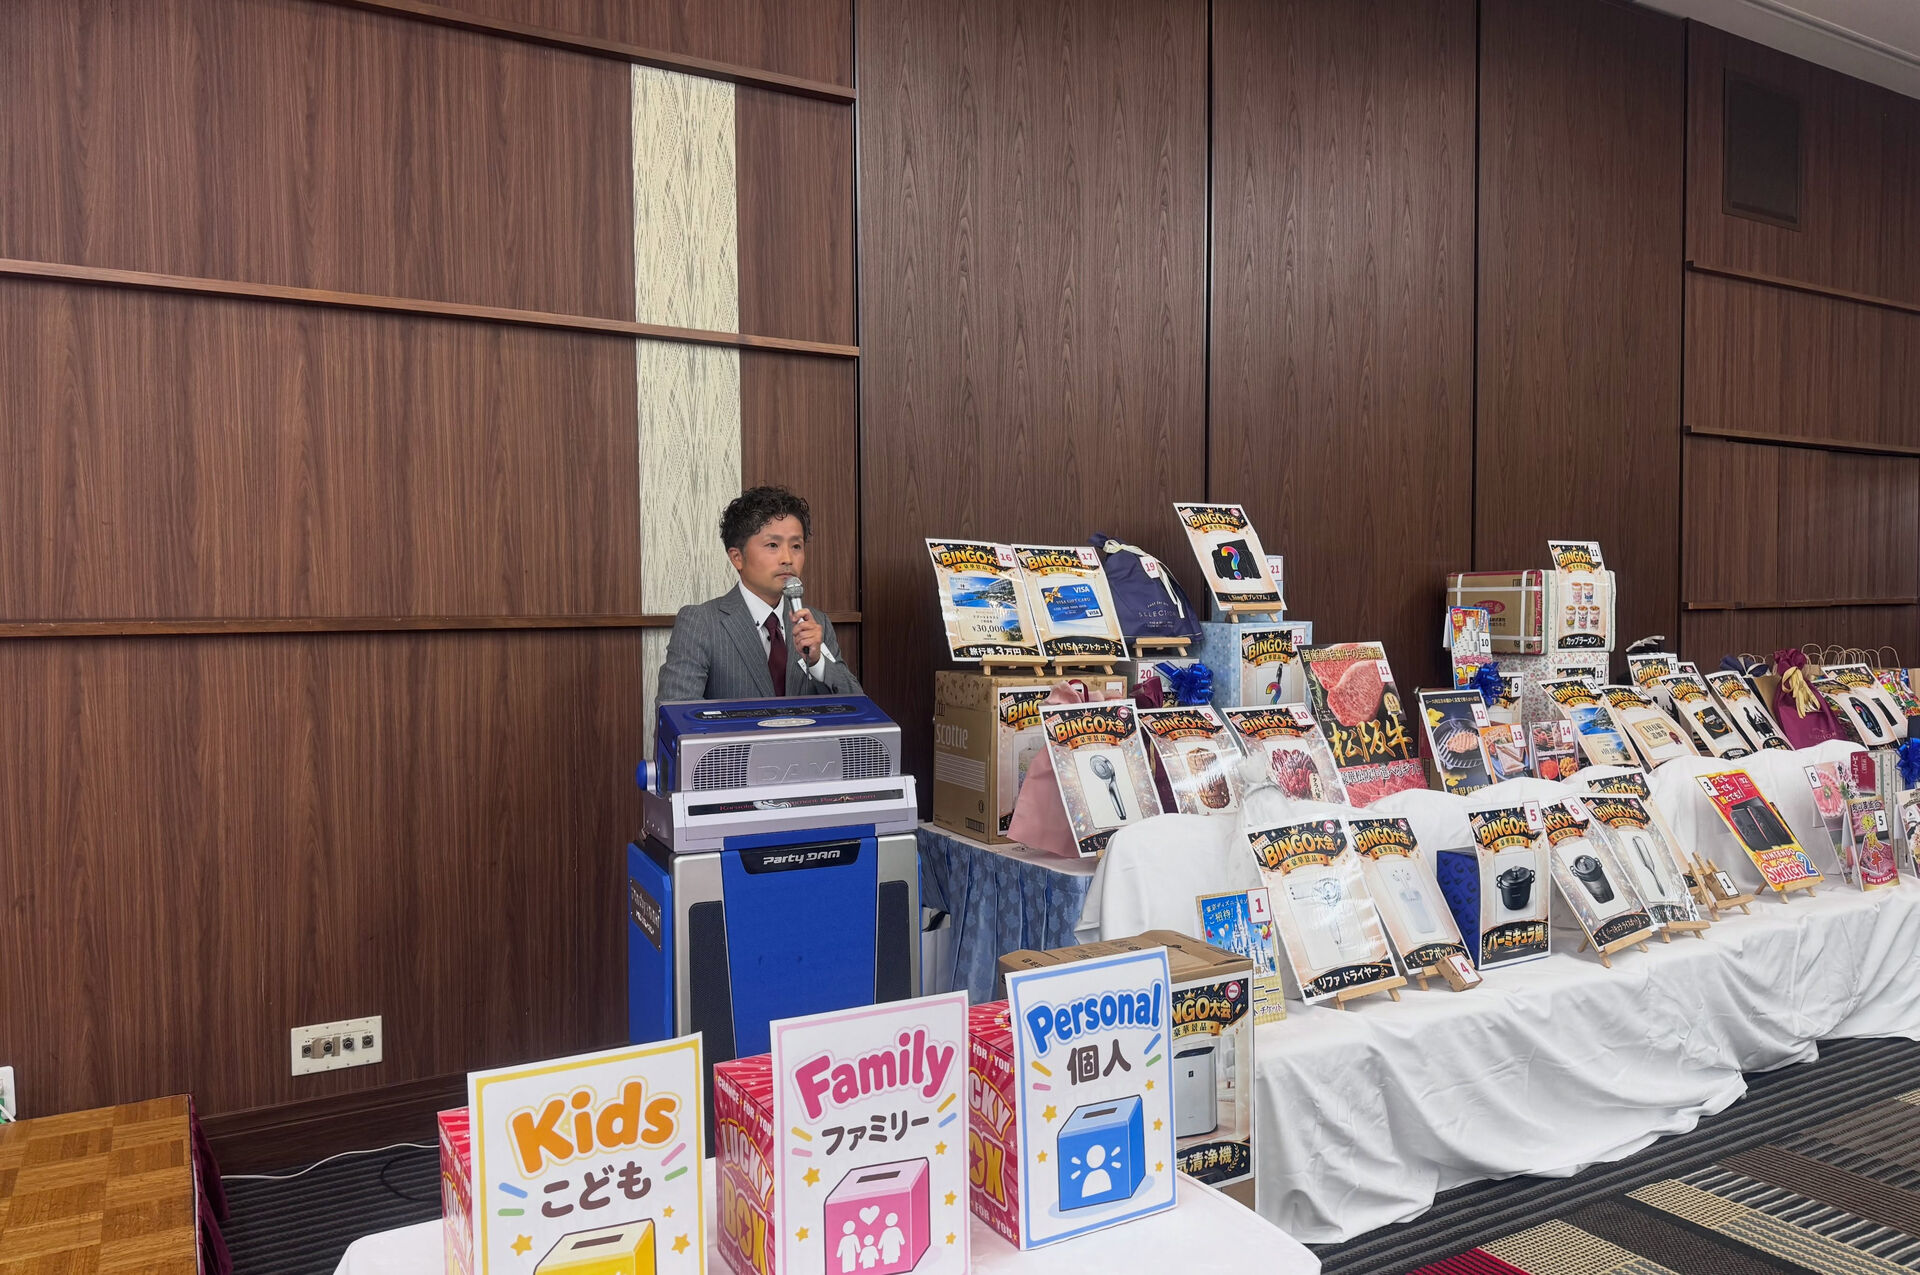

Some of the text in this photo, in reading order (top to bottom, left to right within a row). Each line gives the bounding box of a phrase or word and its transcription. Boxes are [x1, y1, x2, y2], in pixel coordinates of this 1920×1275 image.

[941, 550, 998, 566] BINGO大
[1000, 553, 1012, 562] 16
[1082, 552, 1093, 561] 17
[1559, 551, 1592, 567] BINGO大
[1591, 549, 1599, 557] 11
[1027, 554, 1081, 571] BINGO大
[1145, 563, 1155, 572] 19
[1270, 565, 1279, 574] 21
[1073, 586, 1091, 594] VISA
[972, 624, 1006, 634] ¥30,000
[1293, 635, 1303, 645] 22
[1480, 638, 1490, 647] 10
[1566, 636, 1597, 646] カップラーメン
[1140, 669, 1152, 679] 20
[1380, 666, 1390, 676] 11
[1596, 670, 1604, 679] 12
[1637, 664, 1670, 684] BINGO大
[1513, 682, 1519, 693] 9
[1587, 682, 1597, 690] 13
[1553, 685, 1591, 704] BINGO大
[1204, 712, 1214, 722] 9
[1295, 711, 1309, 720] 10
[1476, 710, 1486, 720] 12
[1055, 715, 1126, 742] BINGO大会
[1240, 714, 1298, 735] BINGO大
[1562, 726, 1571, 736] 14
[935, 723, 969, 749] scottie
[1513, 731, 1523, 740] 13
[1810, 773, 1817, 782] 6
[1703, 781, 1713, 791] 3
[1529, 808, 1537, 822] 5
[1571, 804, 1580, 815] 6
[1878, 815, 1884, 826] 5
[1480, 815, 1530, 846] BINGO大
[1355, 827, 1412, 853] BINGO大会
[1262, 833, 1336, 868] BINGO大会
[1761, 847, 1796, 861] NINTENDO
[763, 850, 840, 866] Party DAM
[1761, 851, 1819, 884] Switch 2
[1722, 878, 1731, 889] 1
[1255, 897, 1264, 913] 1
[1208, 907, 1235, 925] ご招待!
[1460, 961, 1470, 975] 4
[1318, 965, 1379, 991] リファ ドライヤー
[1027, 982, 1162, 1054] Personal
[972, 1042, 1011, 1074] FOR YOU
[1066, 1038, 1132, 1086] 個人
[795, 1029, 954, 1119] Family
[717, 1074, 773, 1137] CHANCE FOR YOU
[512, 1081, 677, 1174] Kids
[821, 1110, 930, 1156] ファミリー
[720, 1121, 773, 1204] LUCKY
[541, 1161, 652, 1218] こども
[724, 1171, 766, 1275] BOX
[975, 1202, 1012, 1239] FOR YOU
